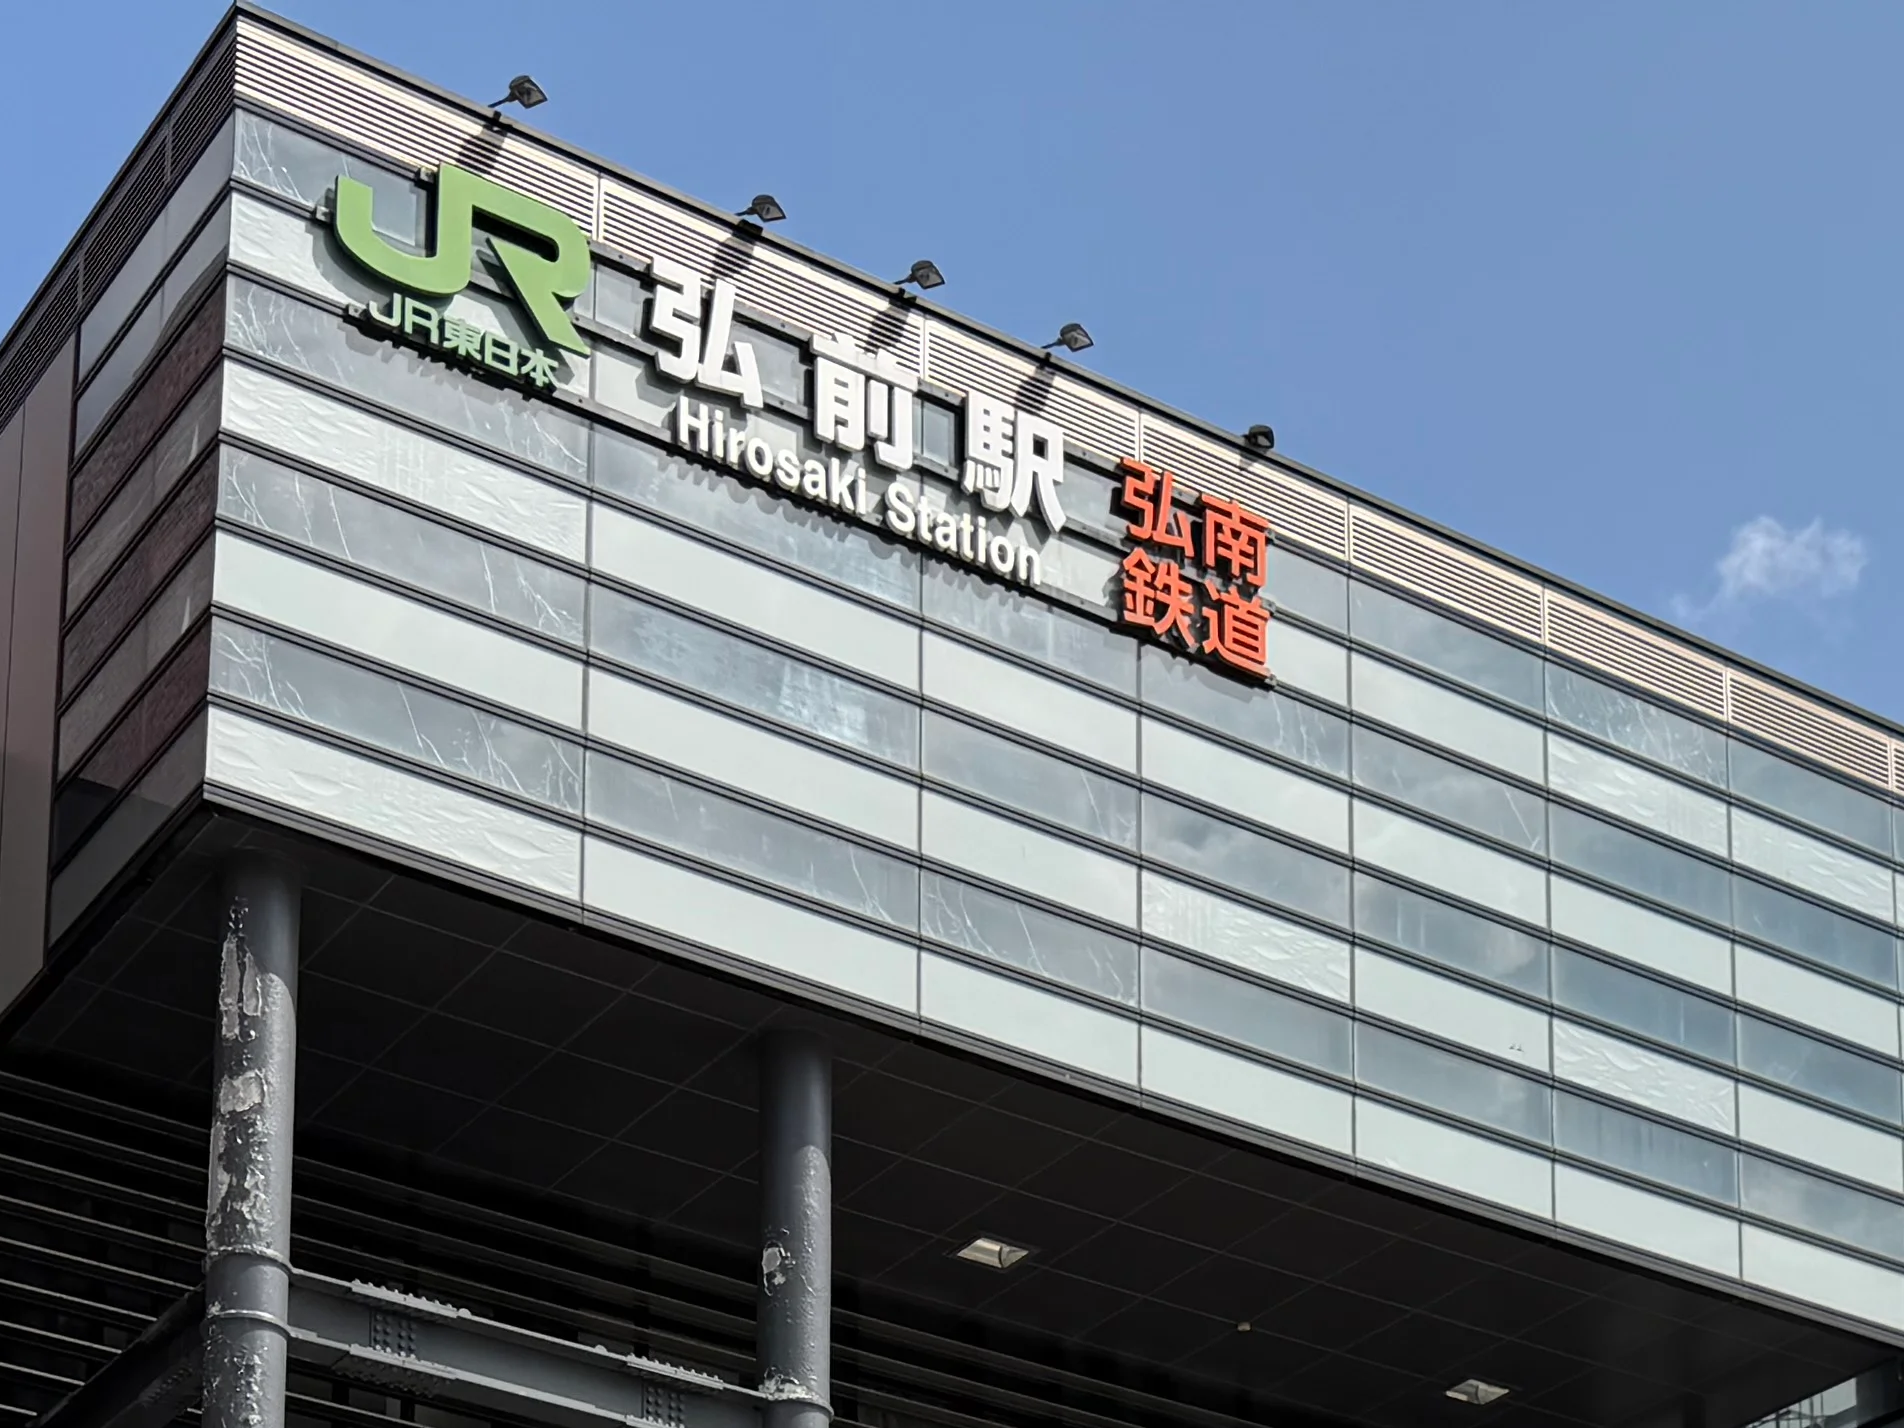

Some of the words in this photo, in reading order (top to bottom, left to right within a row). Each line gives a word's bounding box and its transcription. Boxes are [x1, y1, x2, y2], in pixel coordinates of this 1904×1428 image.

[333, 162, 591, 356] JR
[368, 290, 560, 389] JR東日本
[648, 256, 1068, 533] 弘前駅
[678, 396, 868, 509] Hirosaki
[886, 473, 1043, 584] Station
[1121, 454, 1269, 590] 弘南
[1120, 548, 1270, 682] 鉄道
